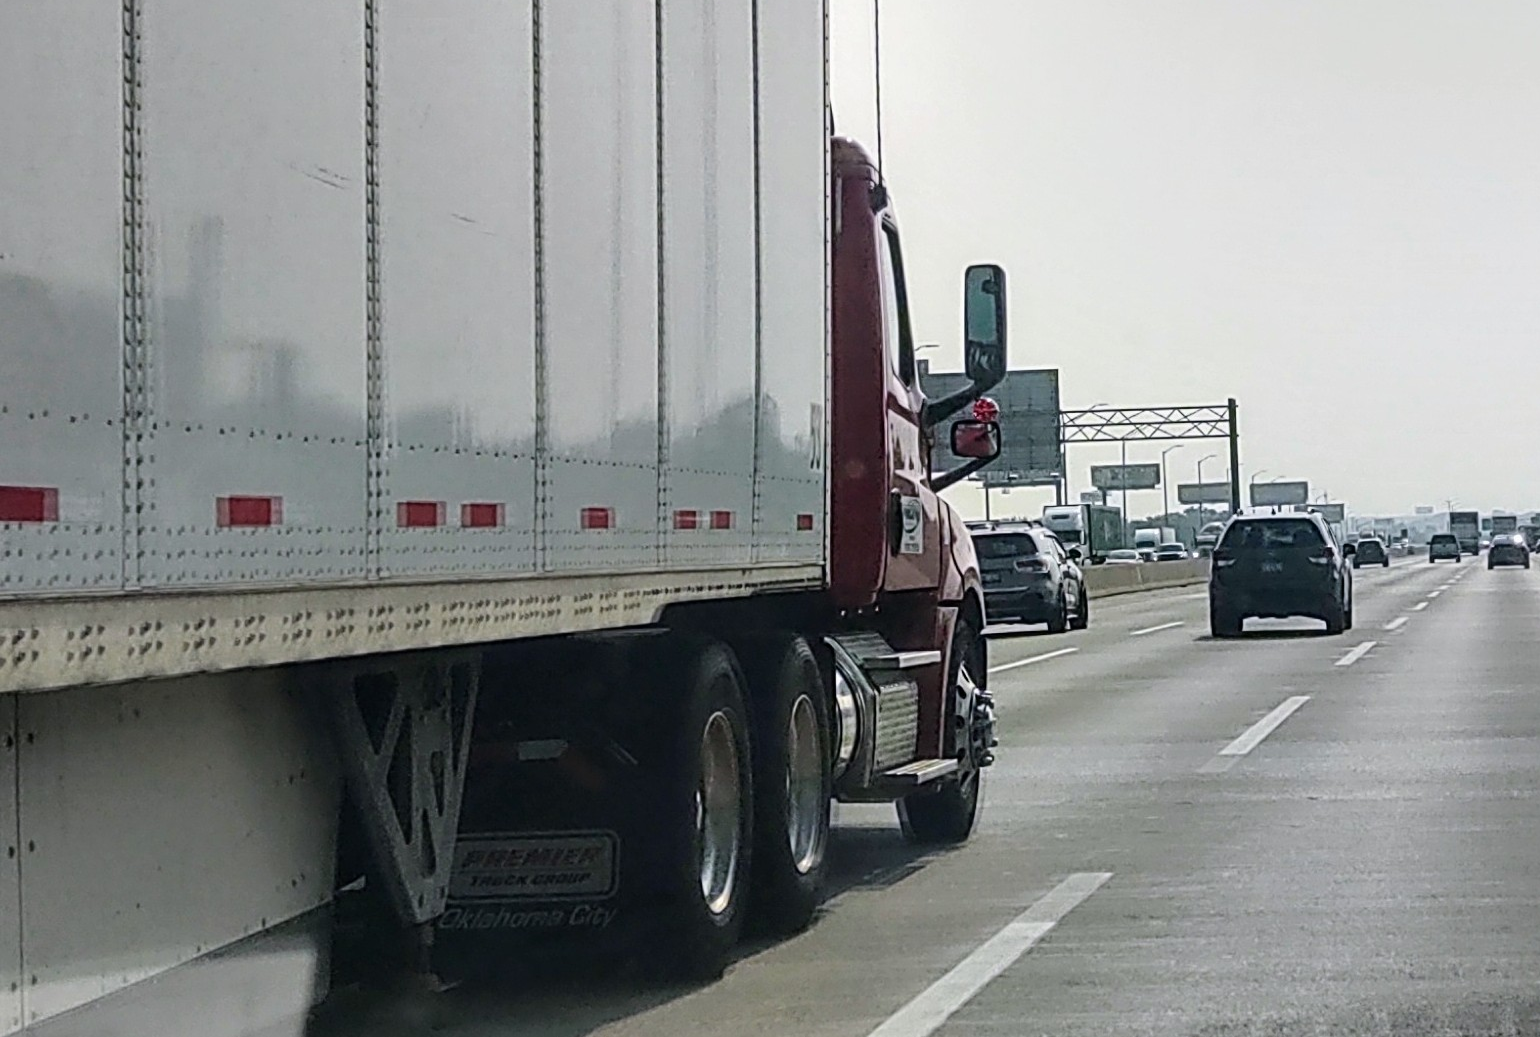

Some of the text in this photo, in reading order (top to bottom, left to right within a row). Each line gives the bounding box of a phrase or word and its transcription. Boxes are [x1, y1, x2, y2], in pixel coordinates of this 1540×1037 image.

[462, 847, 604, 868] PREMIER
[469, 872, 592, 887] TRUCK GROUP
[439, 904, 618, 930] Oklahoma City
